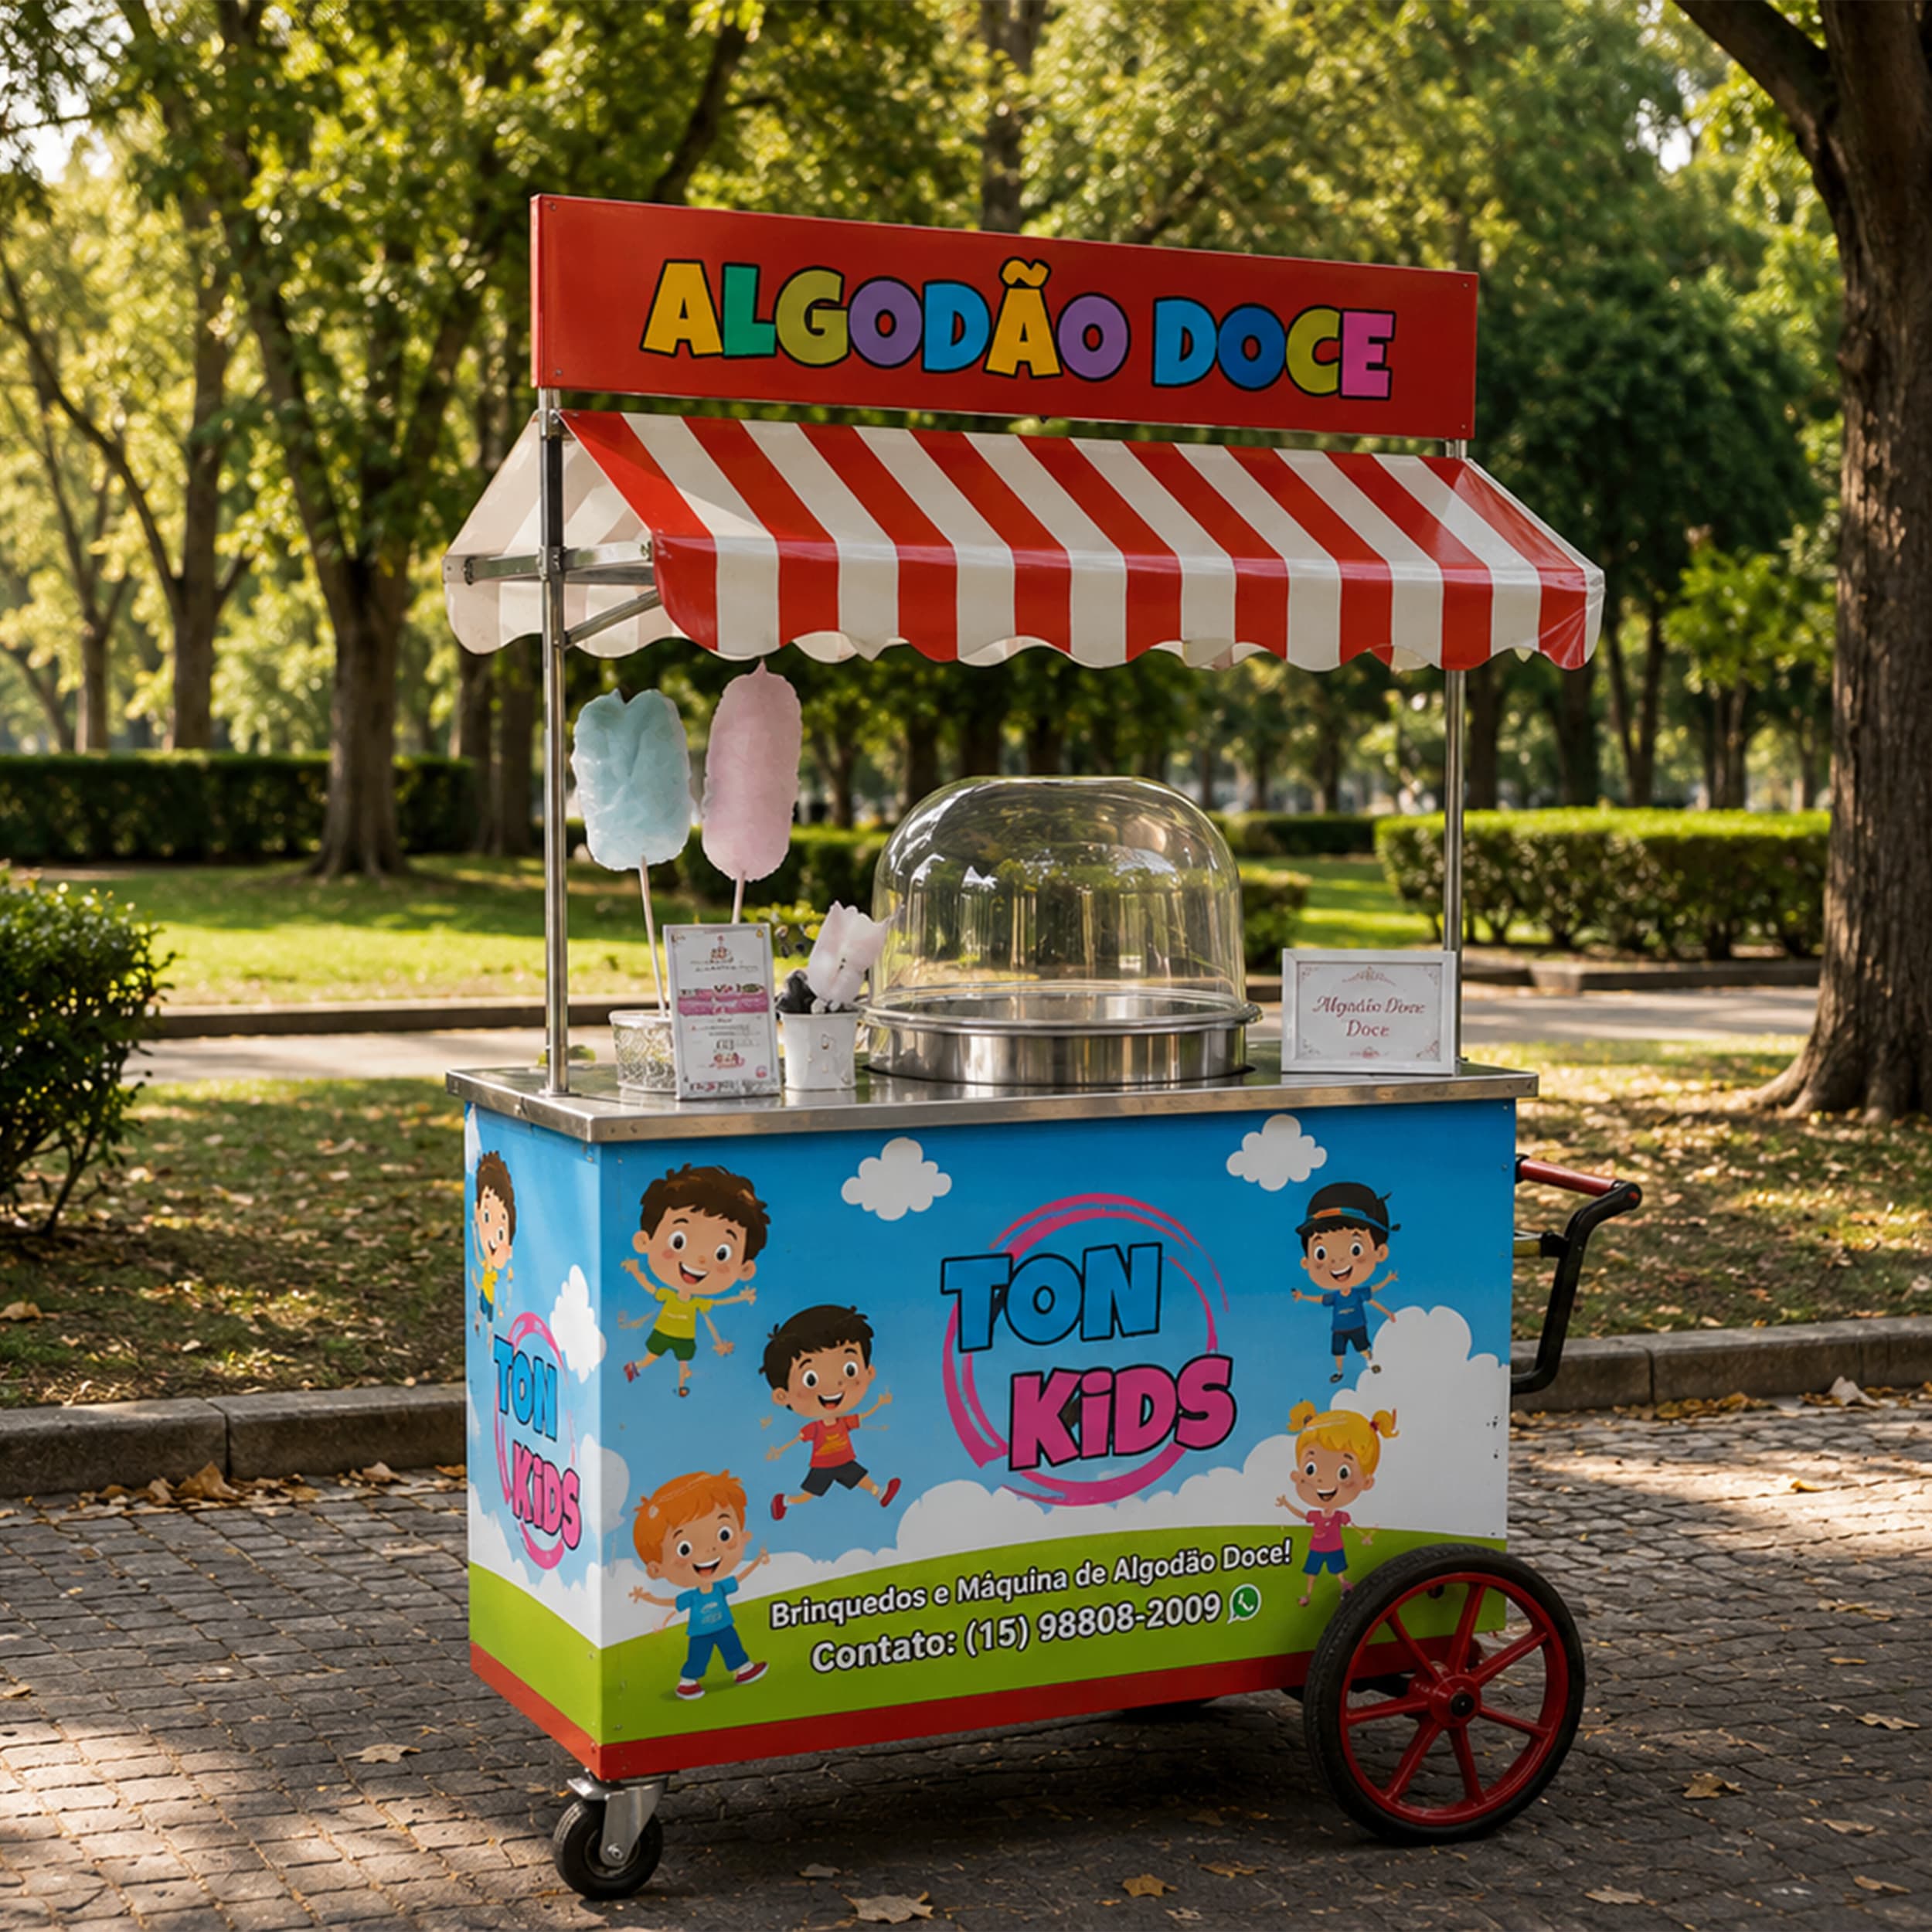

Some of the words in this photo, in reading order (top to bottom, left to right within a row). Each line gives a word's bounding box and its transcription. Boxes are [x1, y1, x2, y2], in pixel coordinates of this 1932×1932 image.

[641, 257, 1130, 381] ALGODÃO
[1151, 297, 1395, 400] DOCE
[1345, 1019, 1390, 1038] Doce
[940, 1241, 1163, 1353] TON
[494, 1334, 558, 1443] TON
[770, 1585, 927, 1629] Brinquedos
[933, 1585, 951, 1606] e
[955, 1566, 1069, 1603] Máquina
[1074, 1560, 1108, 1587] de
[1222, 1537, 1293, 1571] Doce!
[810, 1630, 957, 1672] Contato:
[965, 1614, 1030, 1658] (15)
[1037, 1591, 1223, 1642] 98808-2009
